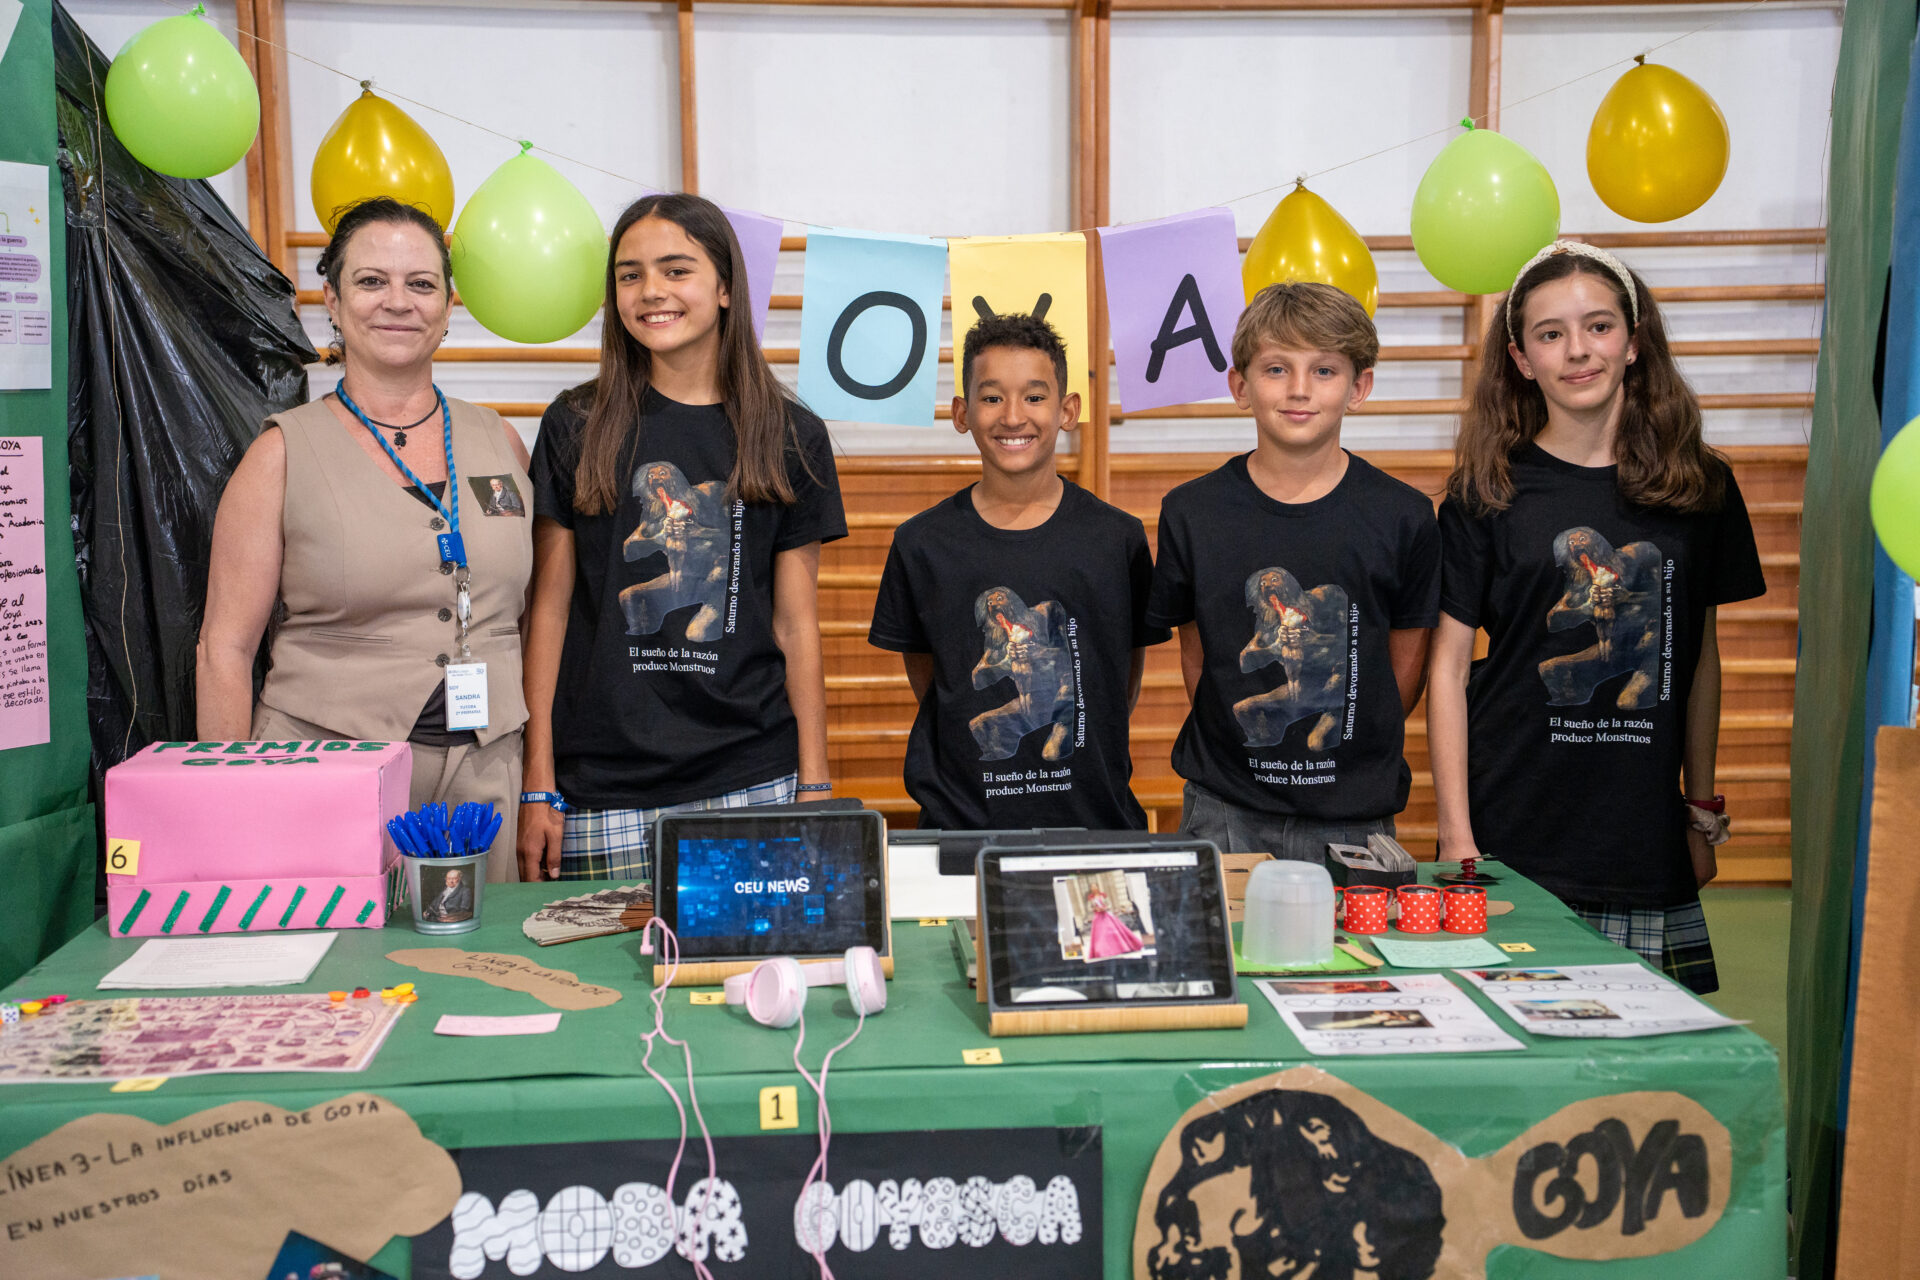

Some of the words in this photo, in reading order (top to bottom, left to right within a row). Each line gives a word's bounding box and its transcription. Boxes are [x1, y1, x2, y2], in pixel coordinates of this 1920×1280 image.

[0, 498, 27, 506] remios
[733, 499, 746, 518] hijo
[735, 519, 741, 531] su
[444, 545, 452, 558] CEU
[0, 565, 44, 582] ofesionales
[729, 542, 741, 593] devorando
[1664, 559, 1675, 579] hijo
[1666, 583, 1672, 594] su
[725, 595, 738, 633] Saturno
[1350, 603, 1359, 623] hijo
[1067, 617, 1078, 637] hijo
[1352, 624, 1358, 637] su
[1662, 606, 1673, 659] devorando
[1071, 638, 1078, 650] su
[630, 647, 638, 657] El
[641, 648, 666, 658] sueño
[668, 648, 679, 658] de
[681, 648, 691, 658] la
[693, 651, 718, 661] razón
[633, 661, 668, 673] produce
[669, 662, 715, 675] Monstruos
[1347, 648, 1358, 700] devorando
[1074, 659, 1085, 709] devorando
[1660, 662, 1671, 701] Saturno
[1075, 711, 1085, 748] Saturno
[1343, 702, 1355, 740] Saturno
[1550, 717, 1561, 727] El
[1564, 718, 1594, 729] sueño
[1597, 718, 1609, 728] de
[1612, 718, 1622, 728] la
[1624, 719, 1654, 730] razón
[152, 739, 390, 754] PREMIOS
[1551, 732, 1592, 743] produce
[1595, 733, 1651, 744] Monstruos
[182, 757, 319, 766] GOYA
[1248, 758, 1258, 769] El
[1261, 759, 1288, 770] sueño
[1291, 760, 1303, 770] de
[1305, 759, 1314, 770] la
[1316, 758, 1335, 769] razón
[983, 772, 993, 782] El
[995, 771, 1023, 782] sueño
[1025, 770, 1037, 780] de
[1039, 769, 1048, 779] la
[1050, 767, 1071, 778] razón
[1254, 773, 1288, 784] produce
[1290, 774, 1335, 785] Monstruos
[986, 784, 1024, 798] produce
[1026, 782, 1072, 794] Monstruos
[111, 845, 127, 869] 6
[734, 881, 763, 894] CEU
[768, 877, 810, 893] NEWS
[771, 1093, 784, 1120] 1
[157, 1112, 273, 1151] INFLUENCIA
[285, 1112, 313, 1127] DE
[325, 1100, 379, 1122] GOYA
[1513, 1117, 1711, 1240] GOYA
[7, 1218, 44, 1241] EN
[53, 1188, 160, 1228] NUESTROS
